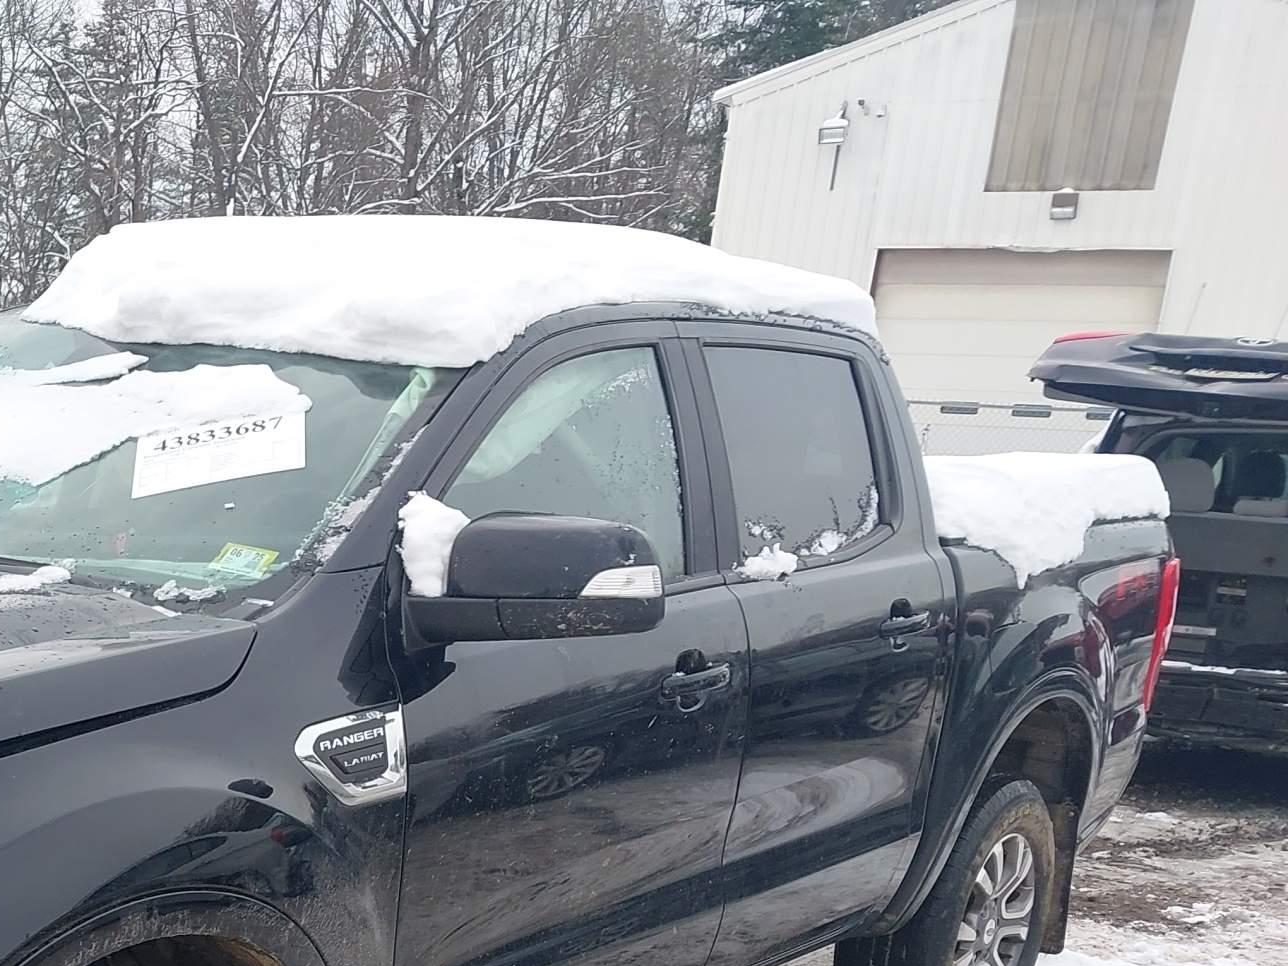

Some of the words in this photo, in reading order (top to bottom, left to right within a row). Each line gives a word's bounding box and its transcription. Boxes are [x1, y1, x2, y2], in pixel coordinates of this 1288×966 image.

[153, 415, 283, 452] 43833687
[319, 726, 384, 752] RANGER
[344, 751, 384, 768] LARIAT
